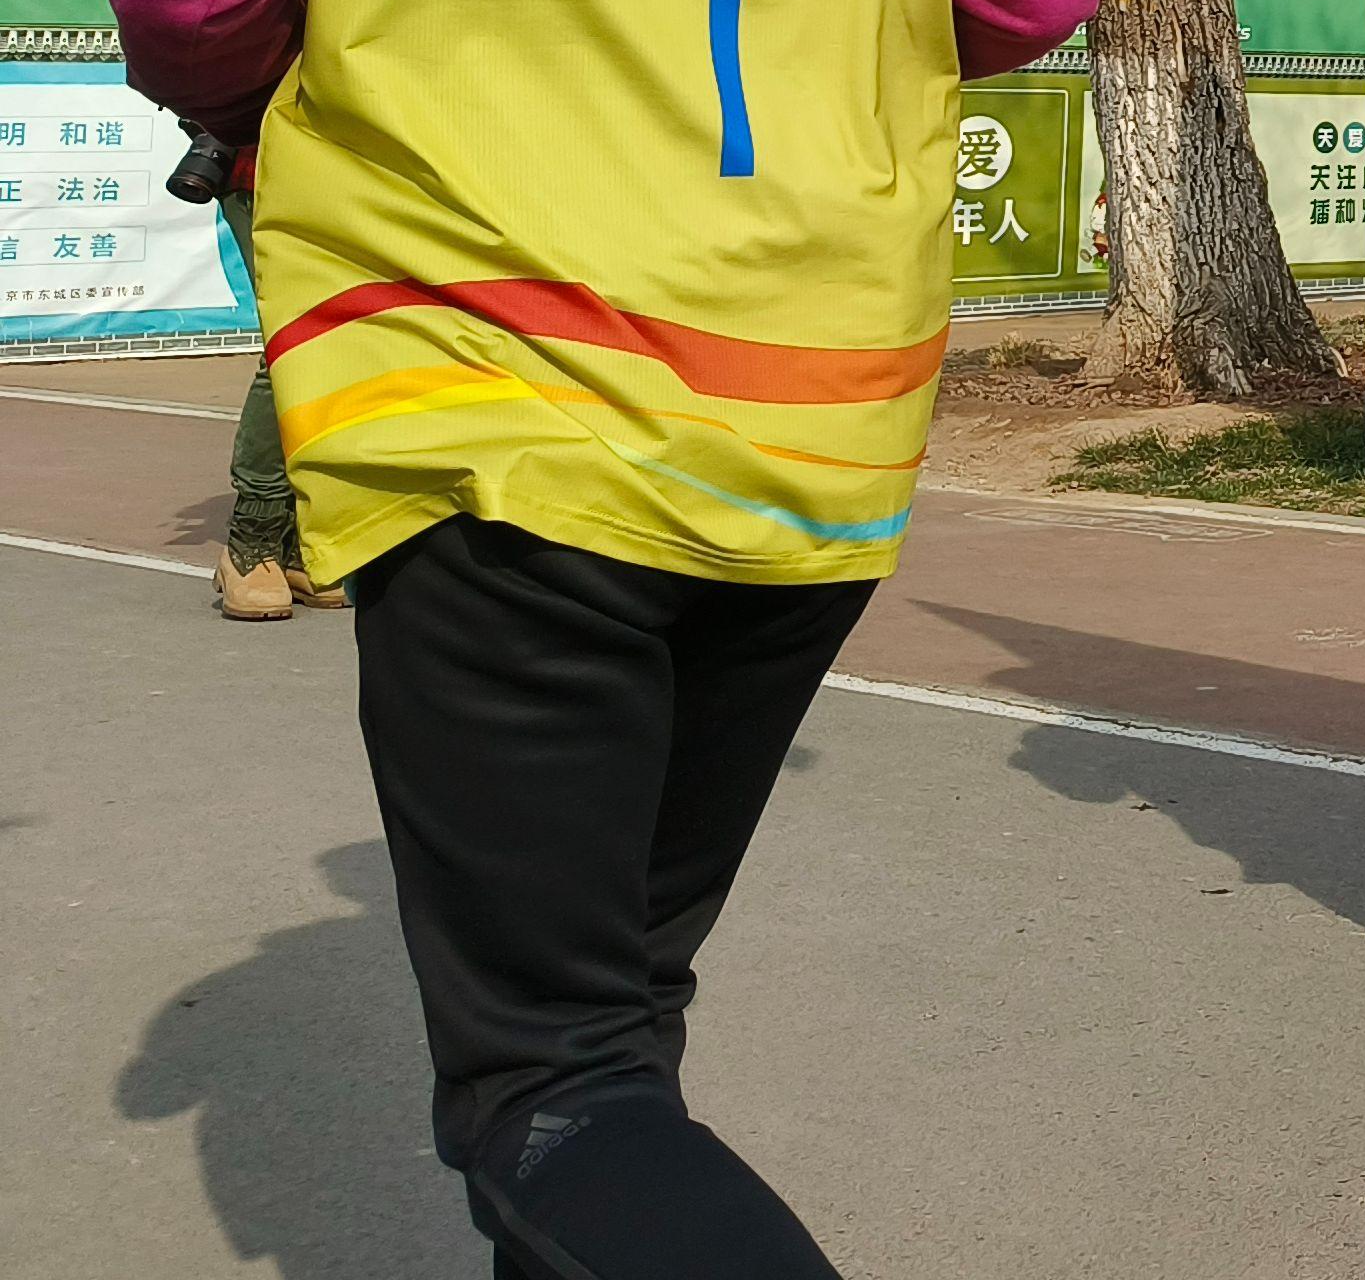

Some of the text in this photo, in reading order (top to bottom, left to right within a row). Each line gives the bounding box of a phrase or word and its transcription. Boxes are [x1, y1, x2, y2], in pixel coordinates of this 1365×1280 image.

[60, 121, 124, 146] 和谐
[956, 127, 1001, 178] 爱
[57, 177, 120, 202] 法治
[53, 233, 117, 259] 友善
